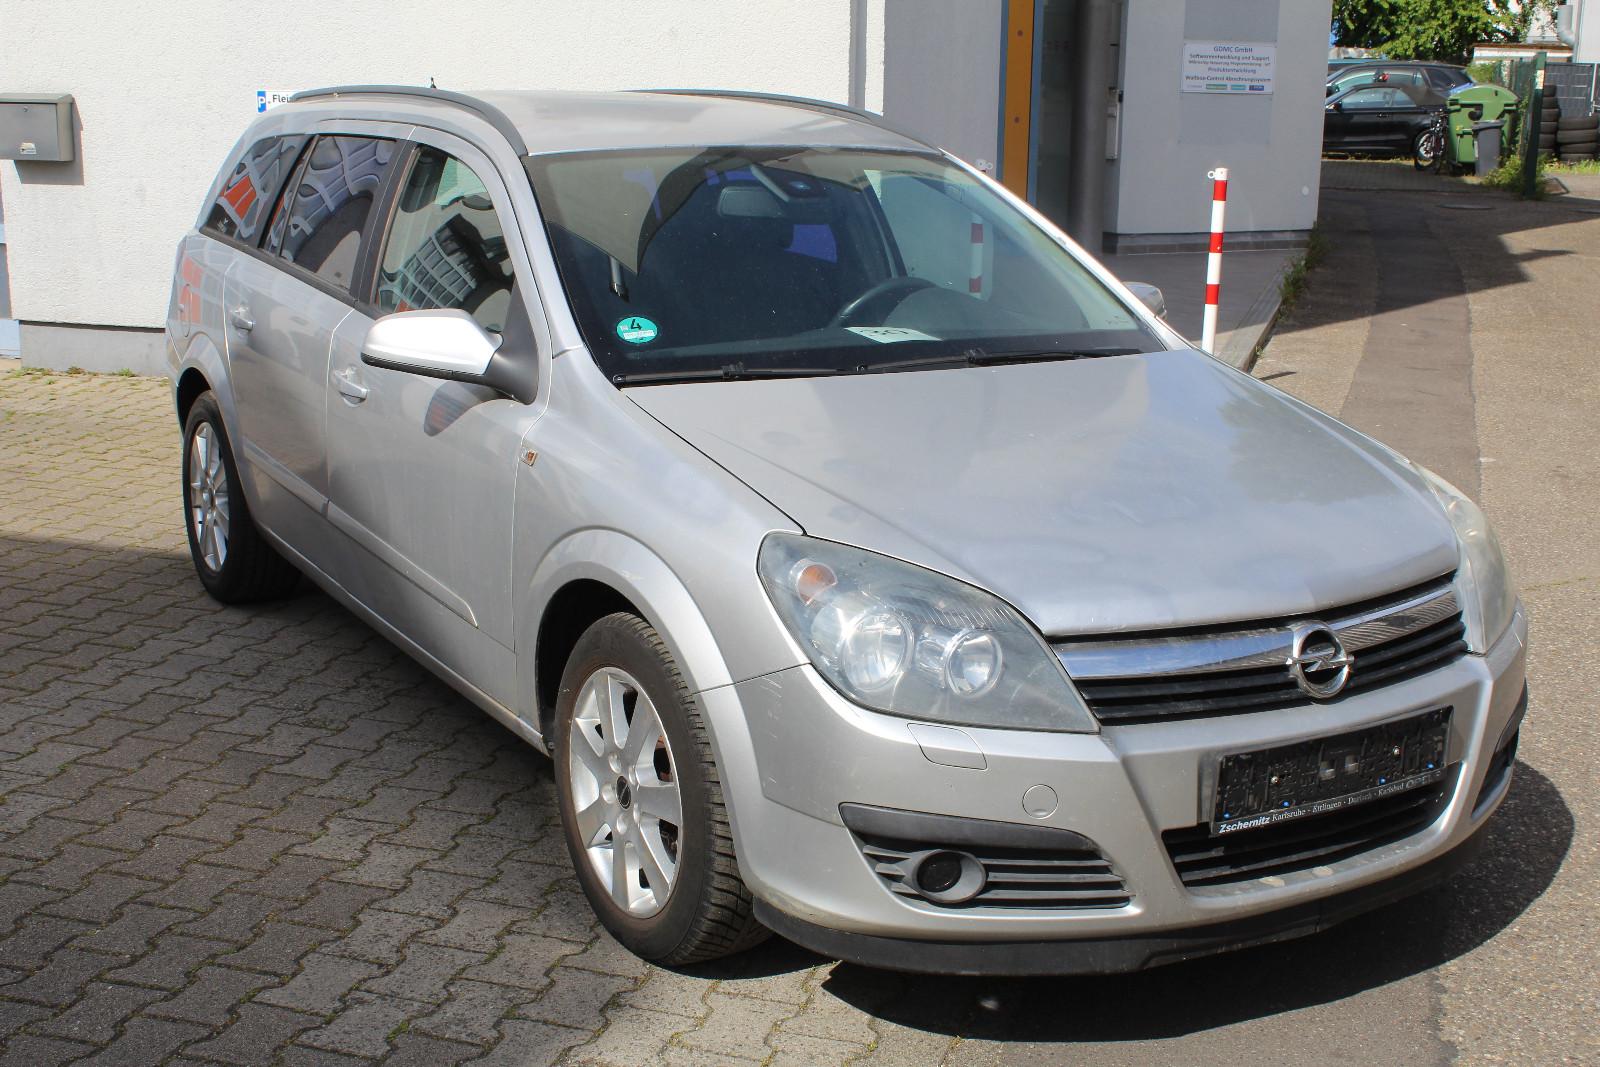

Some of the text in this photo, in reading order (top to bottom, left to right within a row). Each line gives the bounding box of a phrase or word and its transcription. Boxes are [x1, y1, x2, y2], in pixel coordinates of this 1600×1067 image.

[630, 319, 642, 330] 4
[1219, 816, 1270, 833] Zschernitz
[1271, 807, 1306, 822] Karlsruhe
